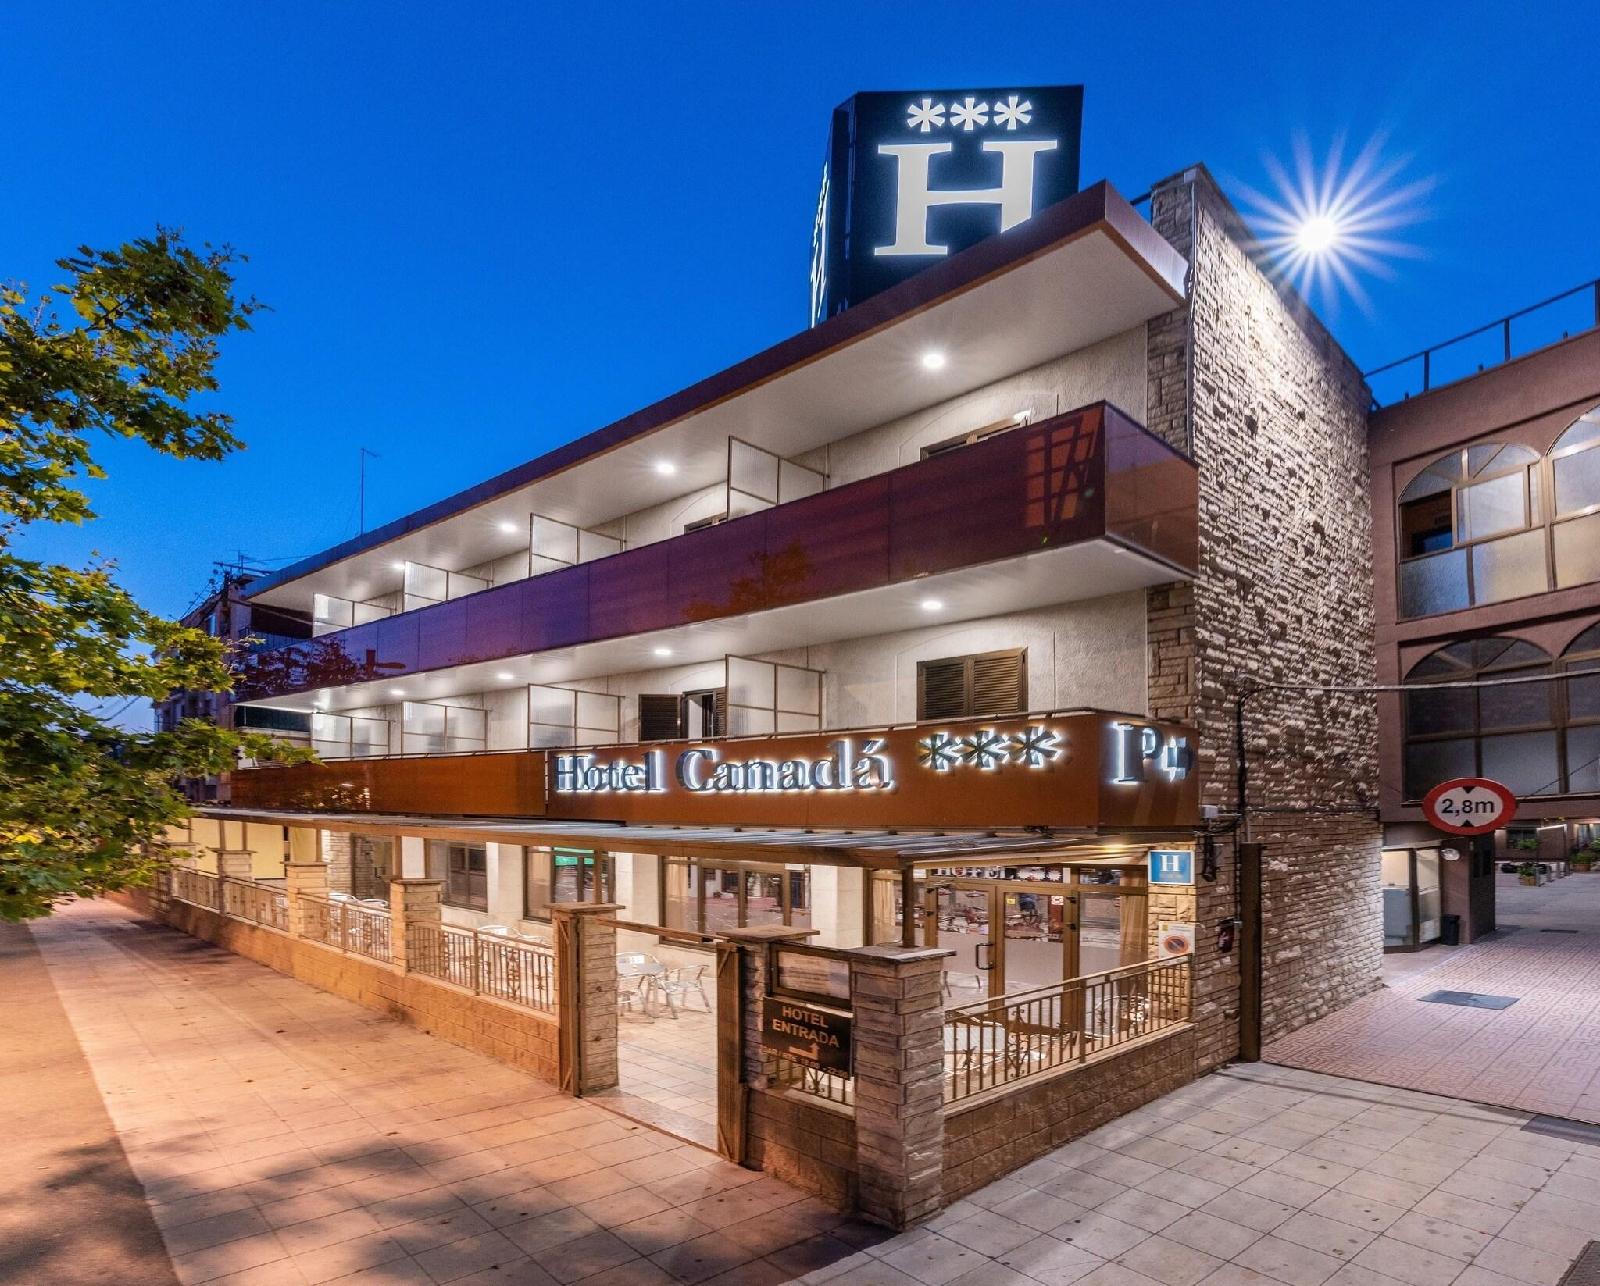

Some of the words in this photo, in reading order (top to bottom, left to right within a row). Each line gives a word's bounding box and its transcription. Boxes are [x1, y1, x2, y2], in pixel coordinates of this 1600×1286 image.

[874, 139, 1058, 256] H
[554, 750, 665, 794] Hotel
[676, 738, 896, 795] Canadá
[1441, 798, 1495, 817] 2,8m
[1160, 854, 1181, 872] H
[782, 1005, 829, 1028] HOTEL
[773, 1018, 840, 1048] ENTRADA
